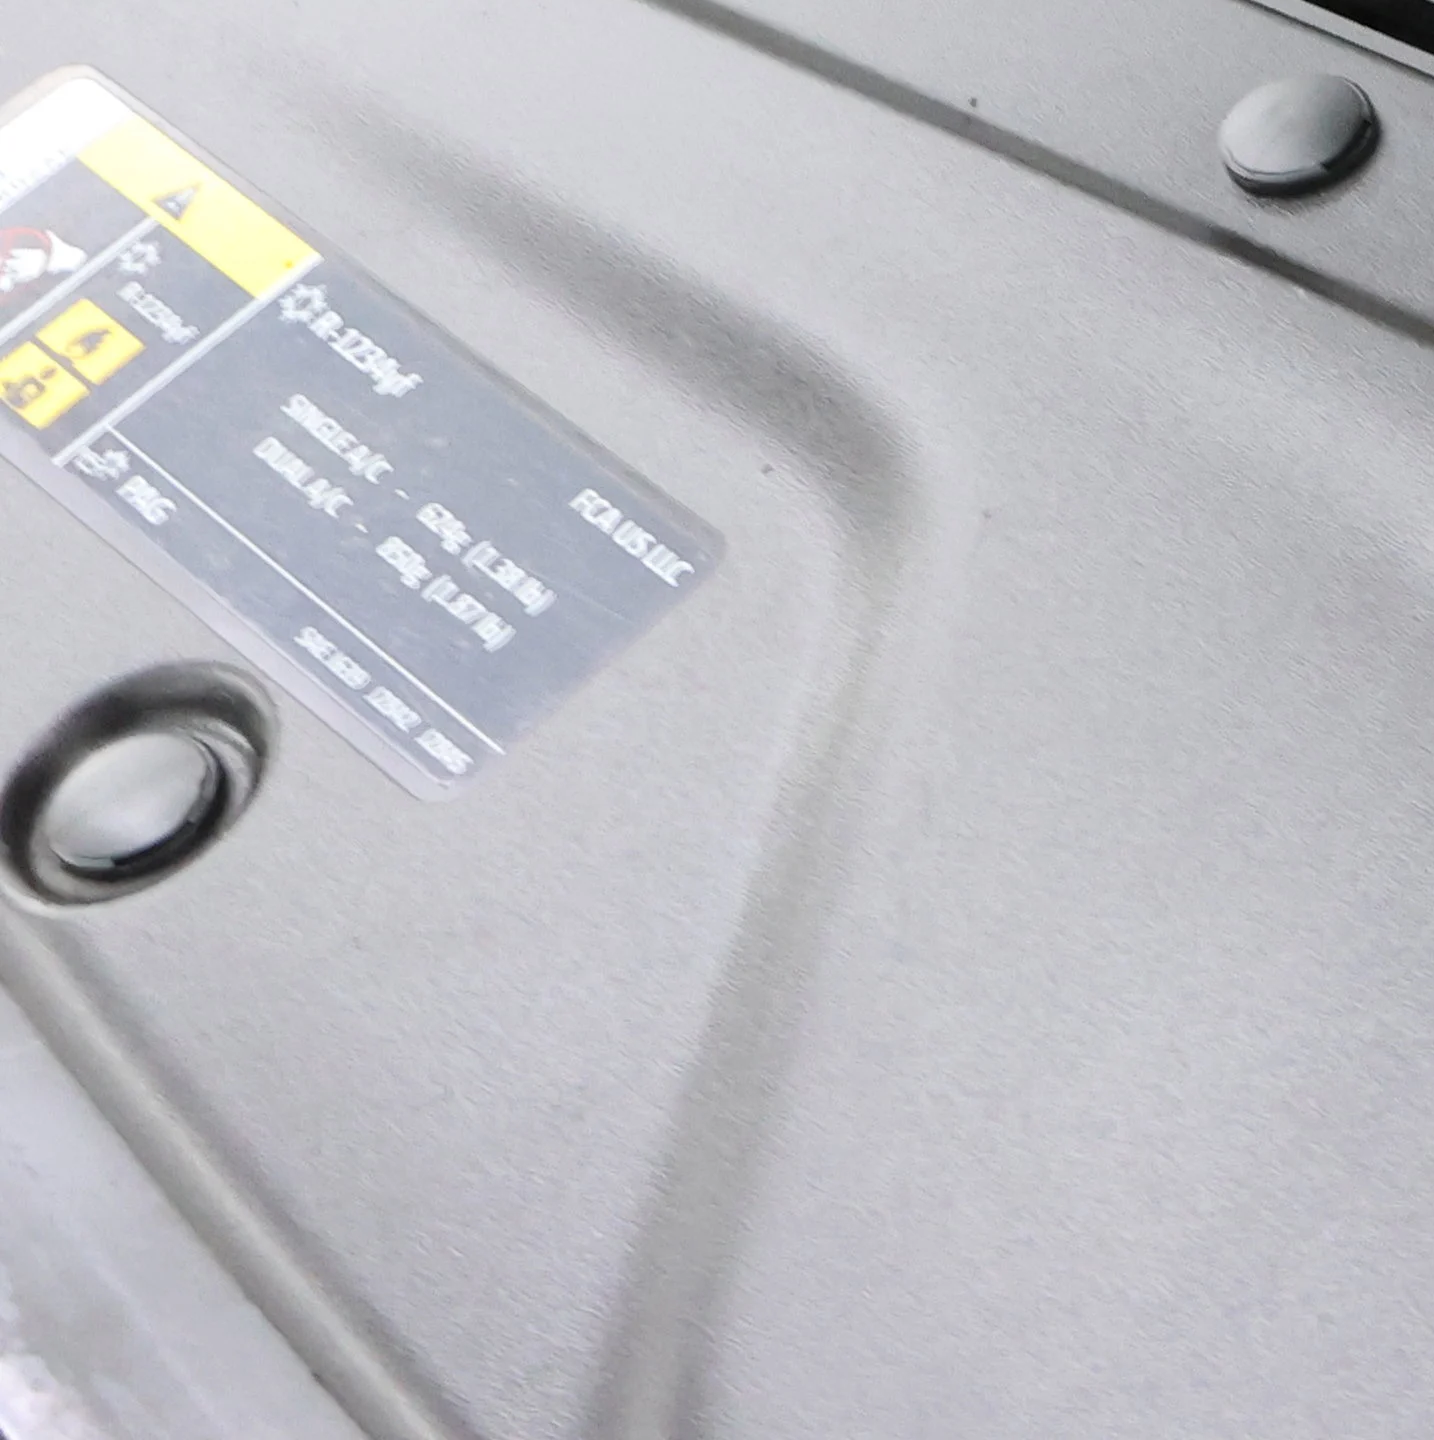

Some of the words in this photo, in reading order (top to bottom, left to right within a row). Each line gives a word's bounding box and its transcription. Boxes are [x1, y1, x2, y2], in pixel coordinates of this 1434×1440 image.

[307, 310, 424, 398] R-1234yf
[115, 474, 178, 526] PAG
[253, 436, 314, 489] DUAL
[301, 478, 354, 519] A/C
[341, 444, 395, 485] A/C
[568, 488, 624, 536] FCA
[612, 520, 657, 559] US
[640, 544, 696, 588] LLC
